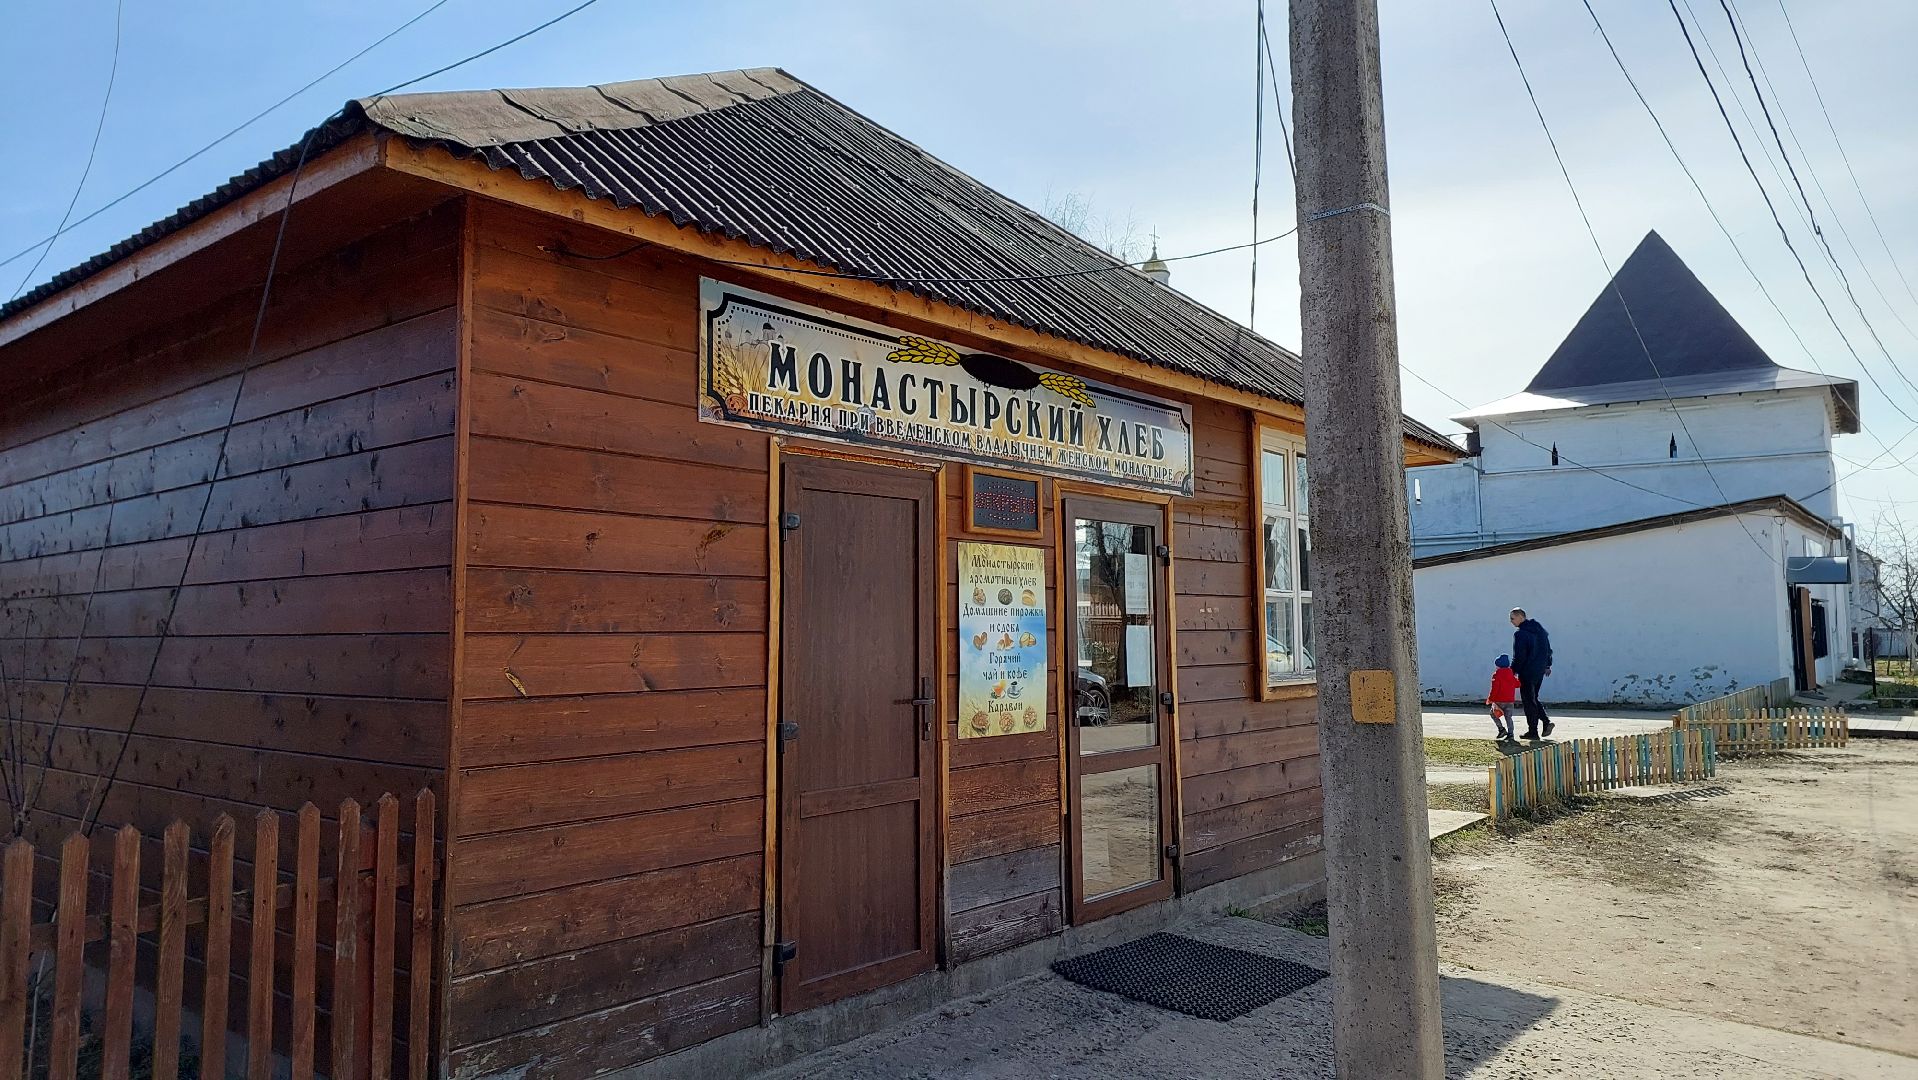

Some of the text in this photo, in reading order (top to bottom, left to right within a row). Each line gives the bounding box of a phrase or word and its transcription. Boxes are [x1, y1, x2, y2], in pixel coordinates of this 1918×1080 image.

[768, 342, 1165, 461] МОНАСТЫРСКИЙ ХЛЕБ
[749, 393, 1173, 481] ПЕКАРНЯ ПРИ ВВЕДЕНСКОМ ВЛАДЫЧНЕМ ЖЕНСКОМ МОНАСТЫРЕ
[975, 492, 1036, 515] ОТКРЫТО
[971, 554, 1034, 572] Монастырский
[1018, 576, 1037, 588] хлеб
[963, 603, 1044, 620] Домашние пирожки
[989, 623, 1020, 633] и сдоба
[989, 652, 1021, 667] Горячий
[982, 668, 1028, 680] чай и кофе
